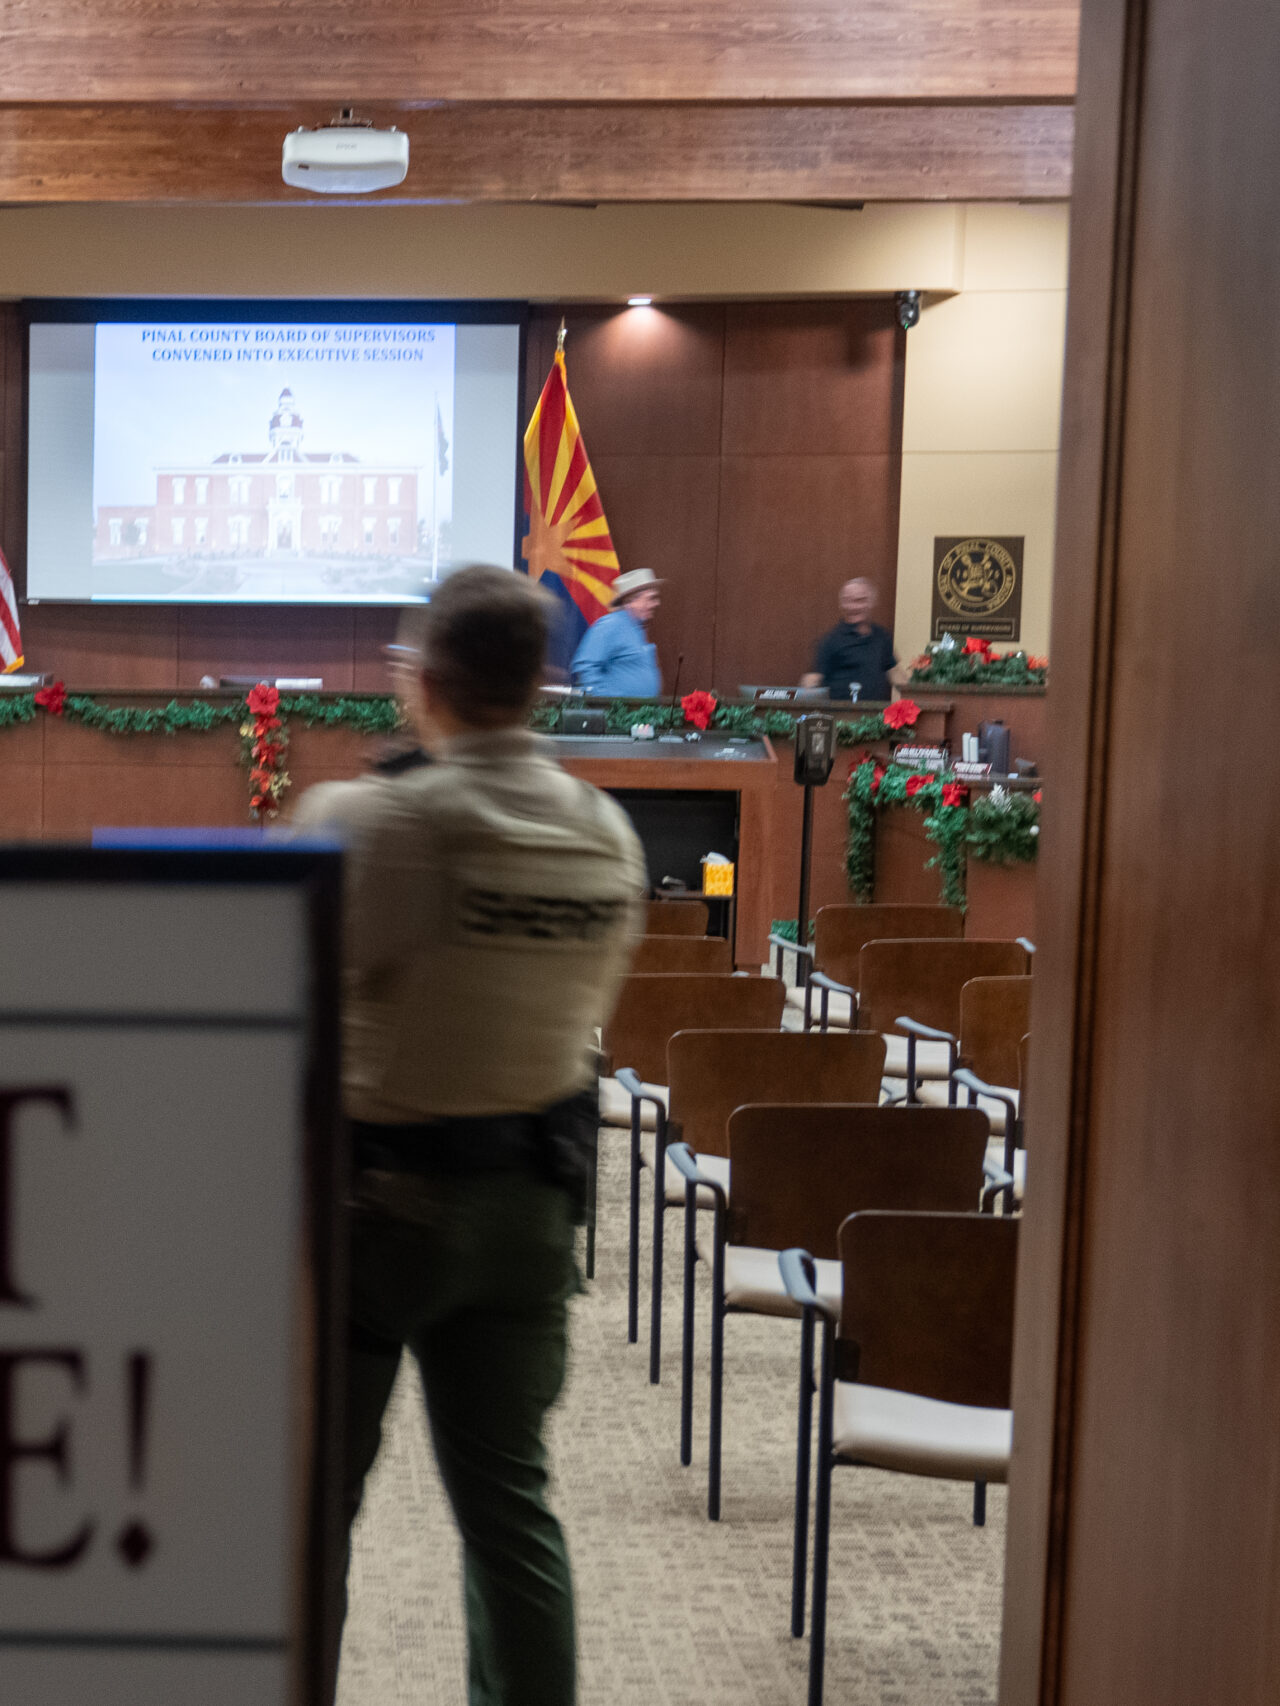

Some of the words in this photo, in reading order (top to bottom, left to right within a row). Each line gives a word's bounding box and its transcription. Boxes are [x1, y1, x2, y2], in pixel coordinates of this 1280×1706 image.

[141, 329, 185, 342] PINAL
[190, 329, 251, 342] COUNTY
[255, 329, 307, 342] BOARD
[311, 329, 330, 342] OF
[334, 329, 436, 342] SUPERVISORS
[152, 348, 232, 361] CONVENED
[237, 348, 273, 361] INTO
[278, 348, 360, 361] EXECUTIVE
[363, 348, 424, 361] SESSION
